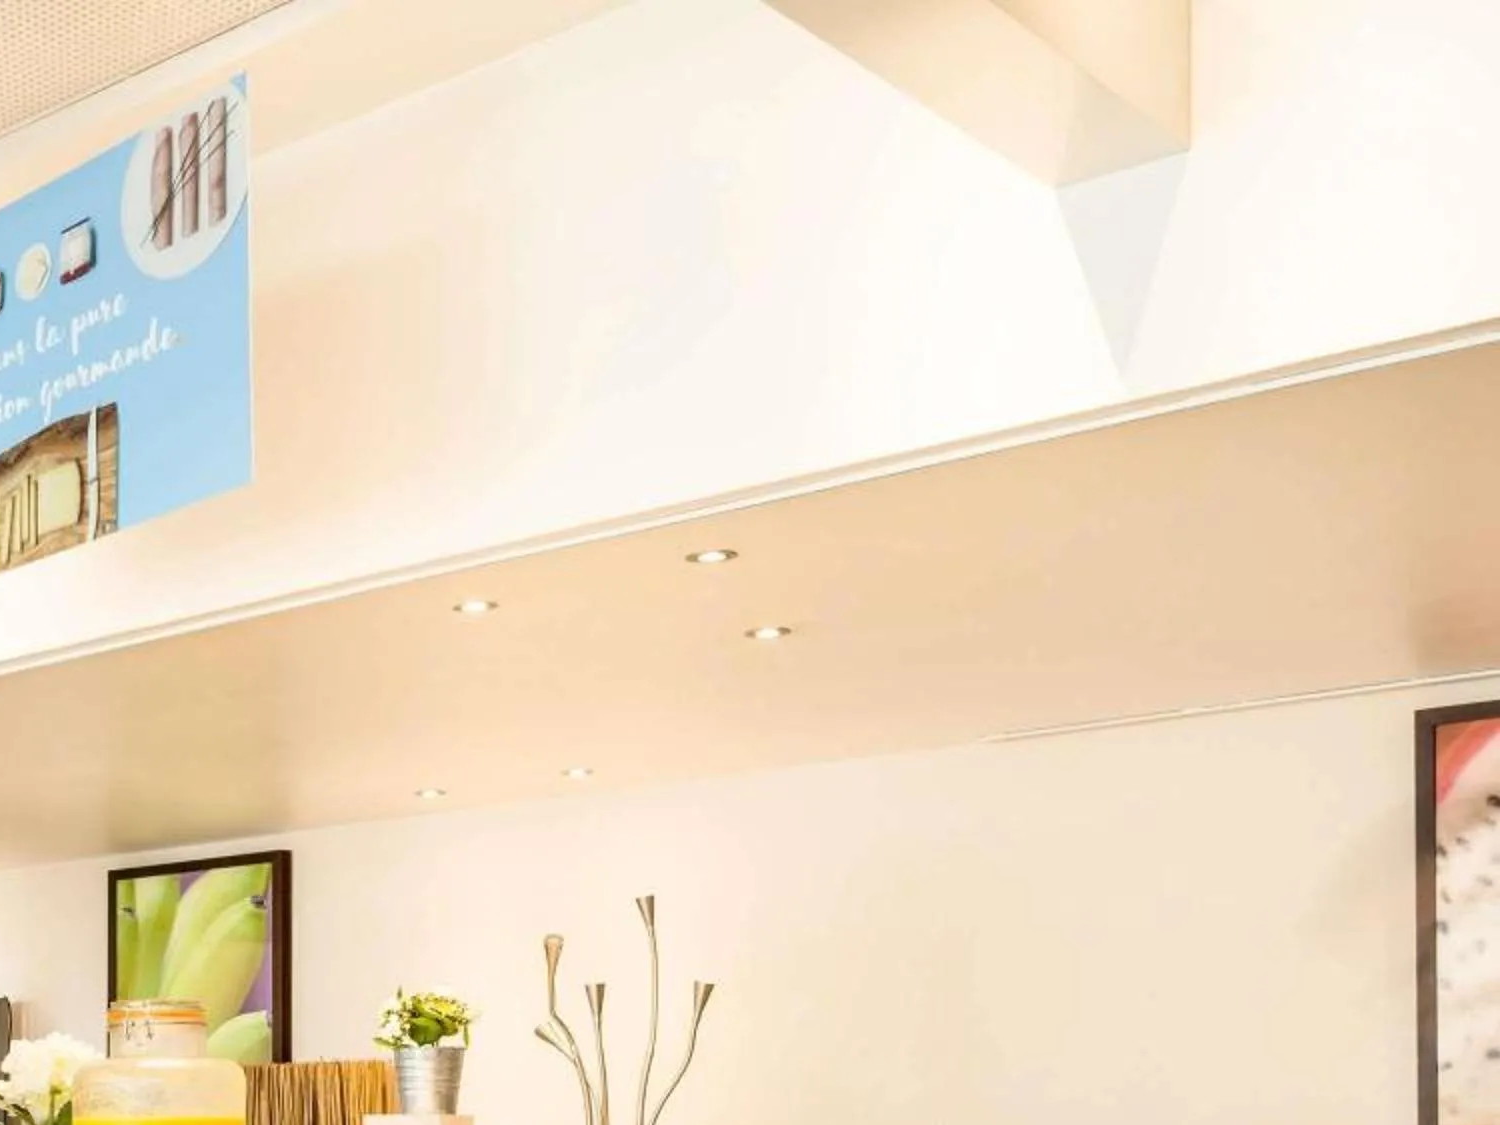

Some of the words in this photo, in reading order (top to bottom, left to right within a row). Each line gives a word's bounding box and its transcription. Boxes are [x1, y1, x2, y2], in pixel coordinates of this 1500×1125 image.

[36, 316, 62, 353] la
[69, 293, 127, 355] pure
[40, 317, 176, 424] gourmande
